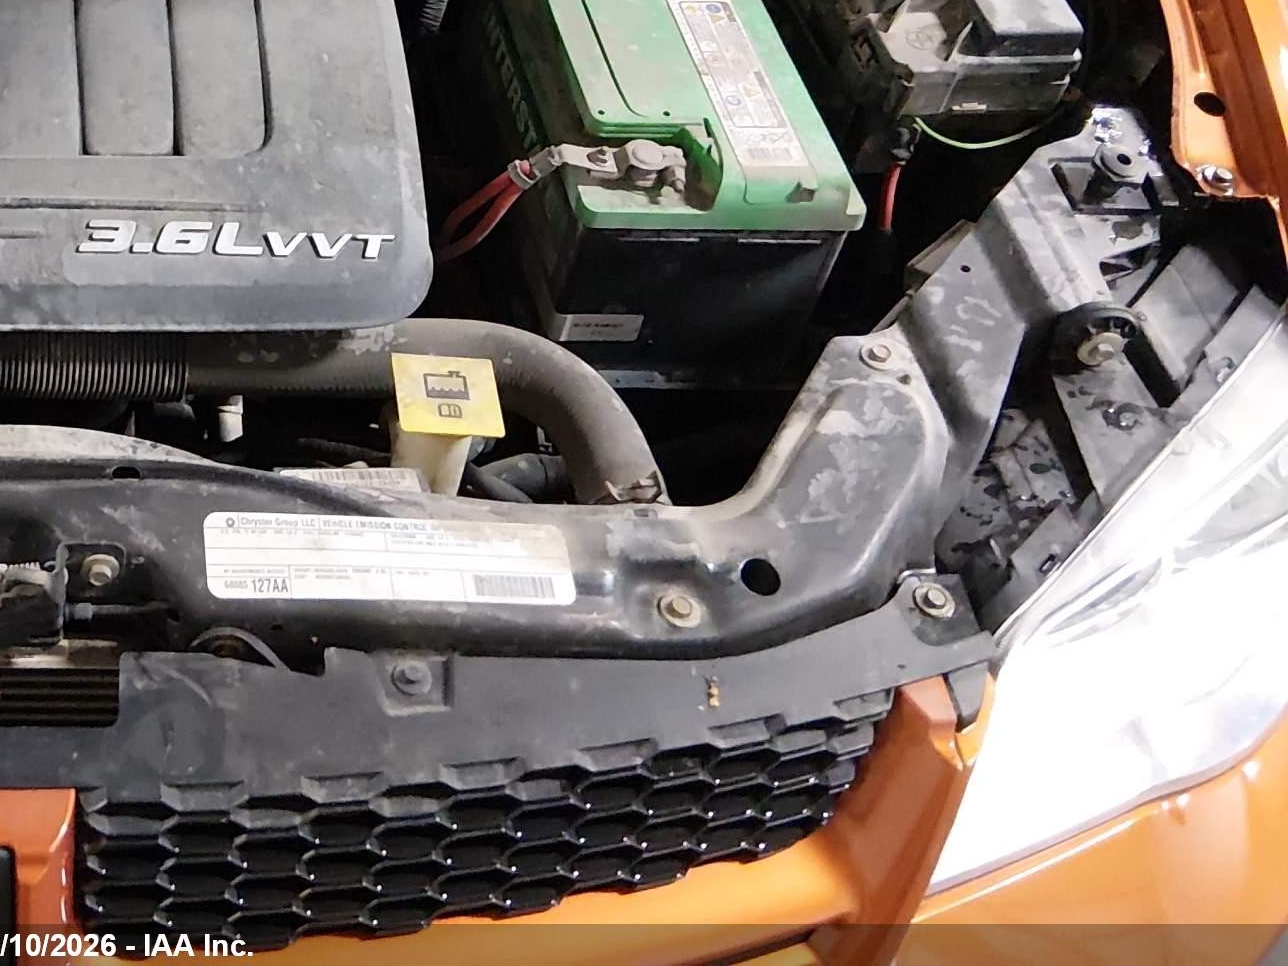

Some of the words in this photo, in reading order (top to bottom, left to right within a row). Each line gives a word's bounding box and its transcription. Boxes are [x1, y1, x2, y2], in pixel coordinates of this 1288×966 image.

[274, 517, 298, 528] Group
[301, 518, 316, 527] LLC
[322, 519, 353, 528] VEHICLE
[251, 577, 289, 593] 127AA
